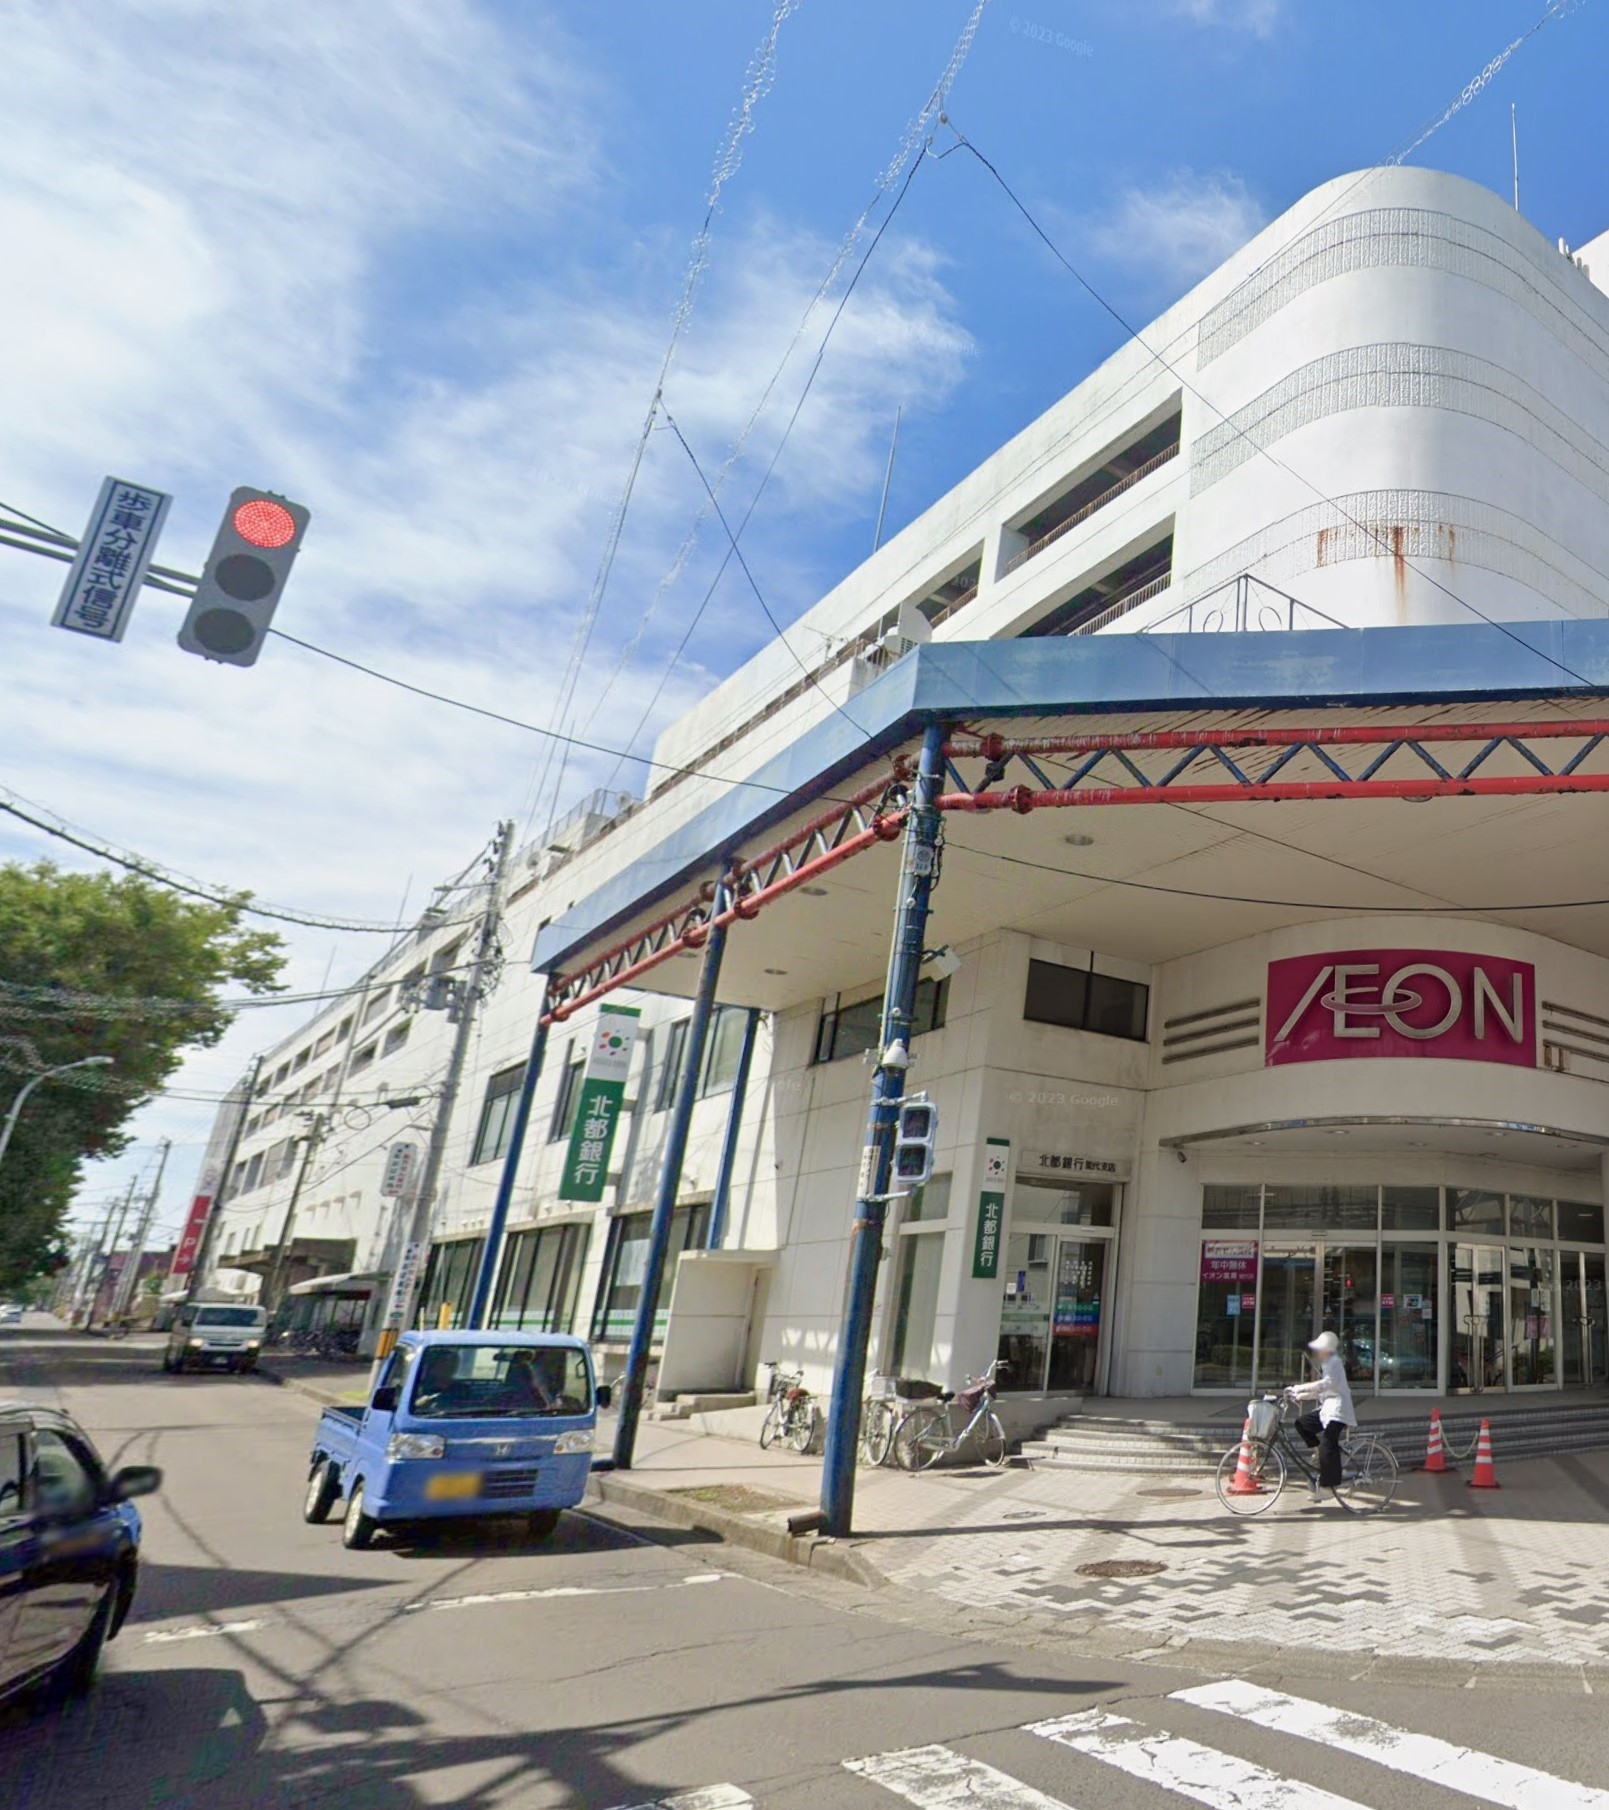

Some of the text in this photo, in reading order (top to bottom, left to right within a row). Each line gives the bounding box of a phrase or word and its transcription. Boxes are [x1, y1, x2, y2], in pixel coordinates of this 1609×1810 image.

[75, 491, 152, 628] 歩車分離式信号
[574, 1095, 613, 1185] 北都銀行
[980, 1203, 999, 1267] 北都銀行
